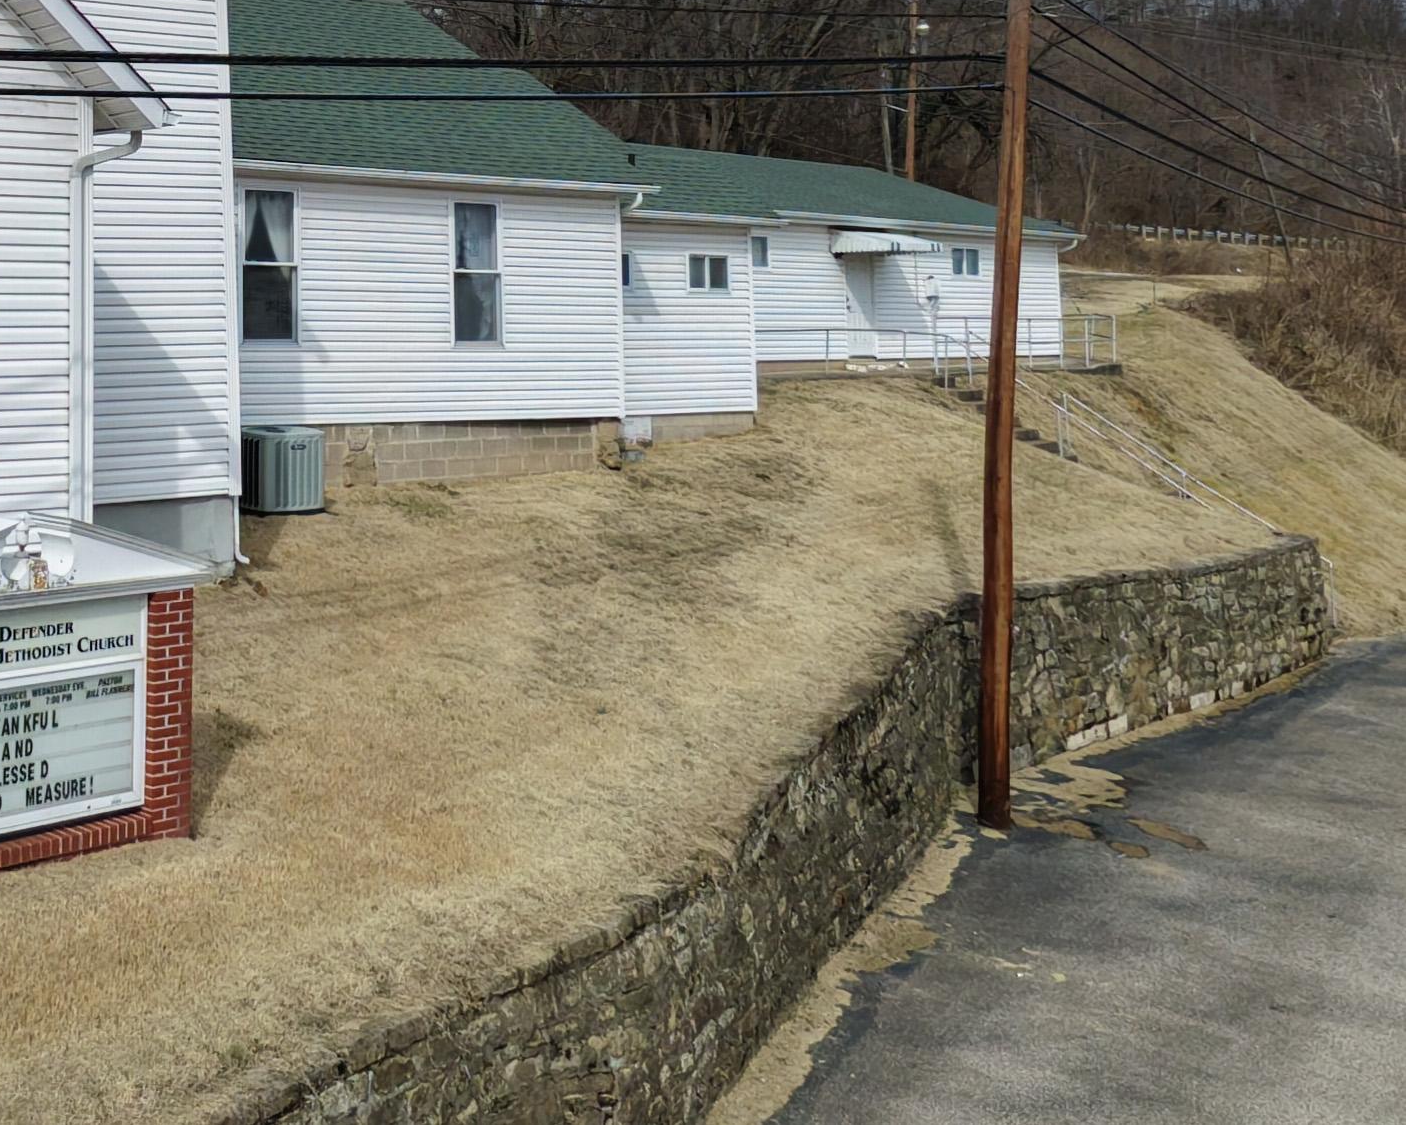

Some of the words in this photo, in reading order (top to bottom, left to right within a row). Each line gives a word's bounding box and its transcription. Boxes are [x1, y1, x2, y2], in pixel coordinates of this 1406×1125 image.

[0, 622, 74, 643] DEFENDER
[77, 634, 134, 653] CHURCH
[20, 700, 31, 710] PM
[1, 738, 34, 761] AND
[26, 775, 94, 807] MEASURE!
